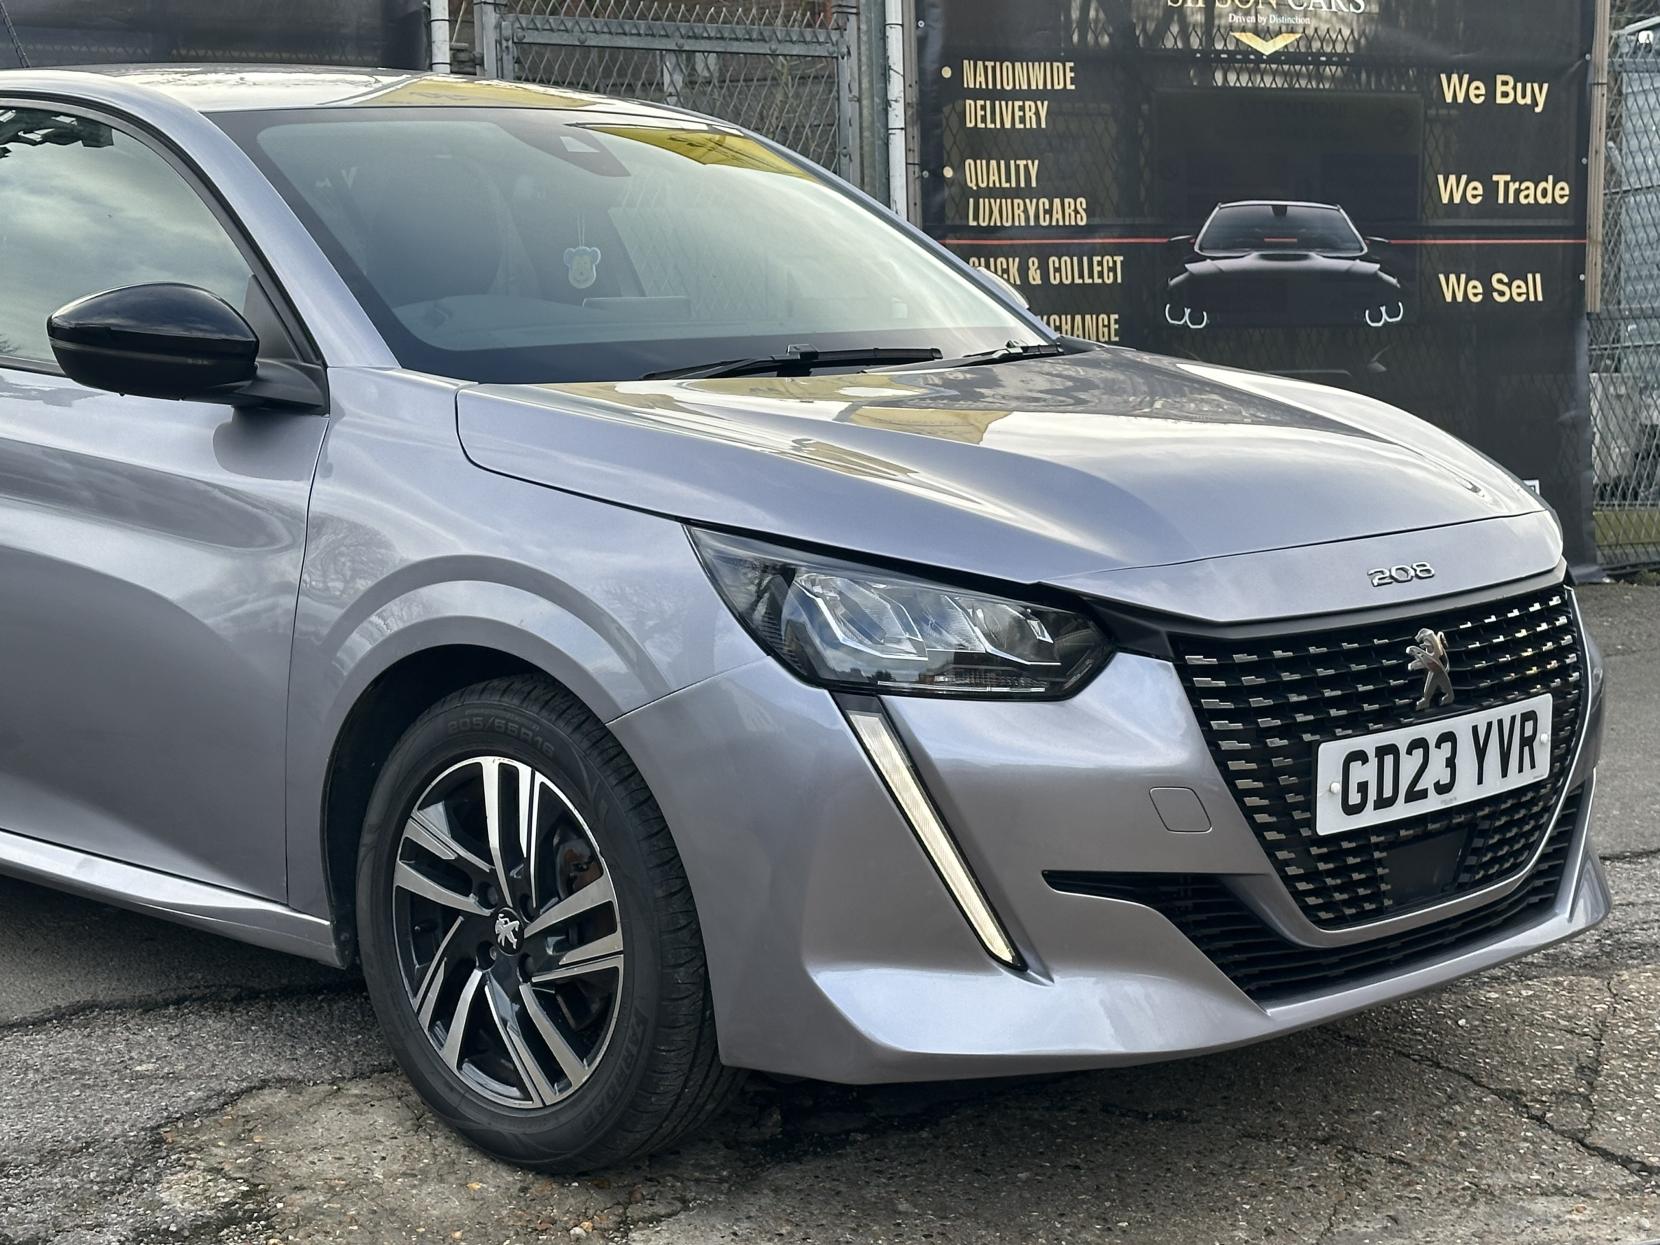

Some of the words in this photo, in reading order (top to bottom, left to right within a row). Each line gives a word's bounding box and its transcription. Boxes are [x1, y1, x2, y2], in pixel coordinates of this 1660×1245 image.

[1228, 13, 1256, 24] Driven
[1257, 14, 1268, 25] by
[1269, 14, 1311, 24] Distinction
[963, 60, 1076, 90] NATIONWIDE
[1440, 73, 1486, 104] We
[1495, 74, 1549, 113] Buy
[965, 99, 1048, 129] DELIVERY
[964, 159, 1039, 190] QUALITY
[1437, 174, 1483, 205] We
[1492, 174, 1570, 205] Trade
[968, 198, 1087, 227] LUXURYCARS
[1028, 257, 1042, 285] &
[1048, 255, 1124, 285] COLLECT
[1438, 273, 1483, 303] We
[1491, 272, 1543, 303] Sell
[1368, 561, 1435, 587] 208
[1340, 729, 1458, 816] GD23
[1471, 709, 1538, 785] YVR
